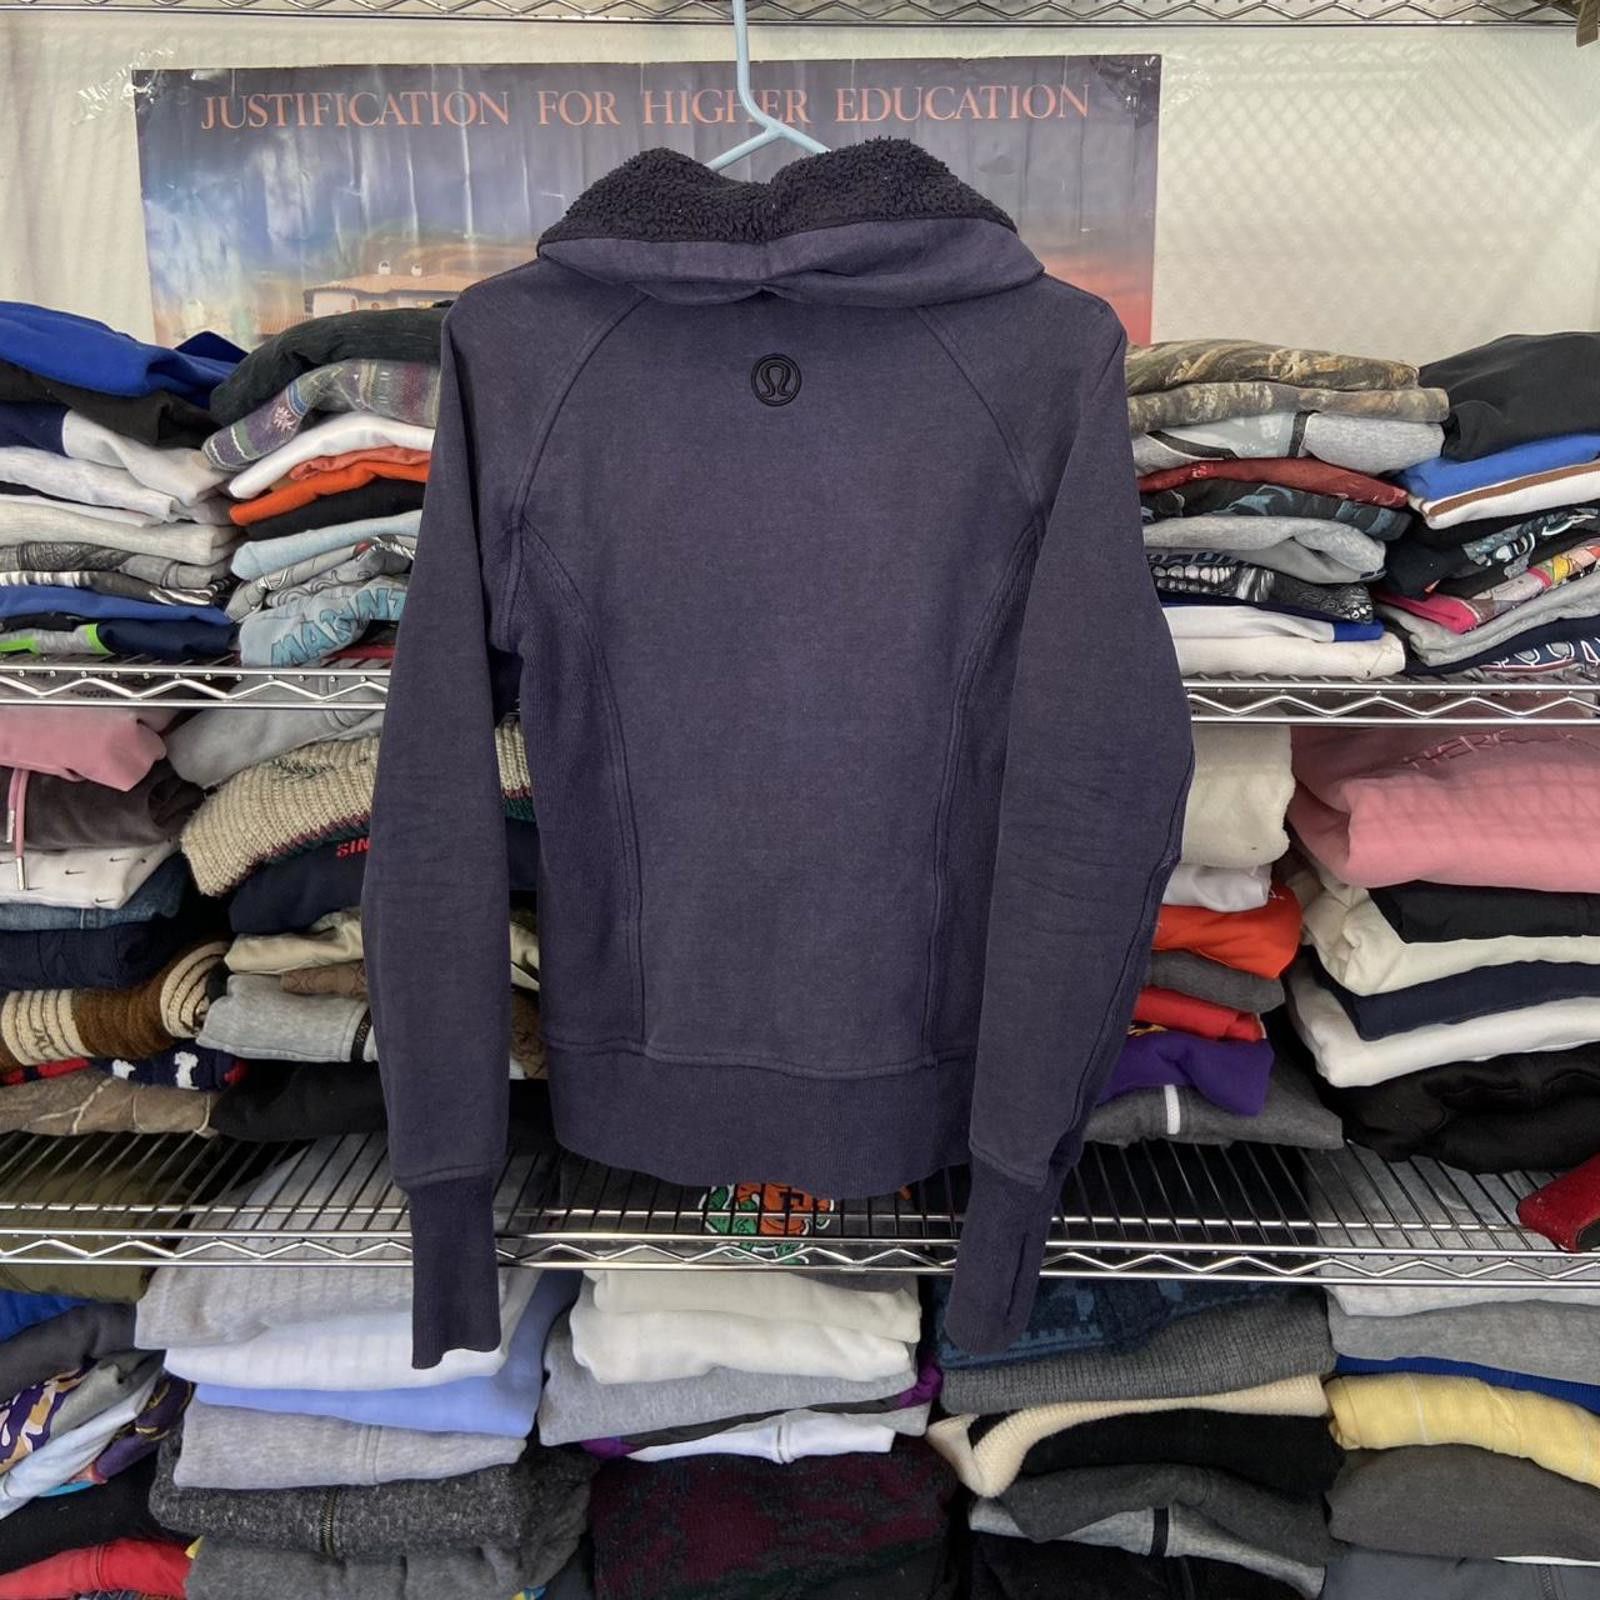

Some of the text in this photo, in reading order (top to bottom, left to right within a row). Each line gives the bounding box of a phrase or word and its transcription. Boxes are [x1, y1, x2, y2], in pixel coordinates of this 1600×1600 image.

[200, 83, 1091, 130] JUSTIFICATION FOR HIGHER EDUCATION
